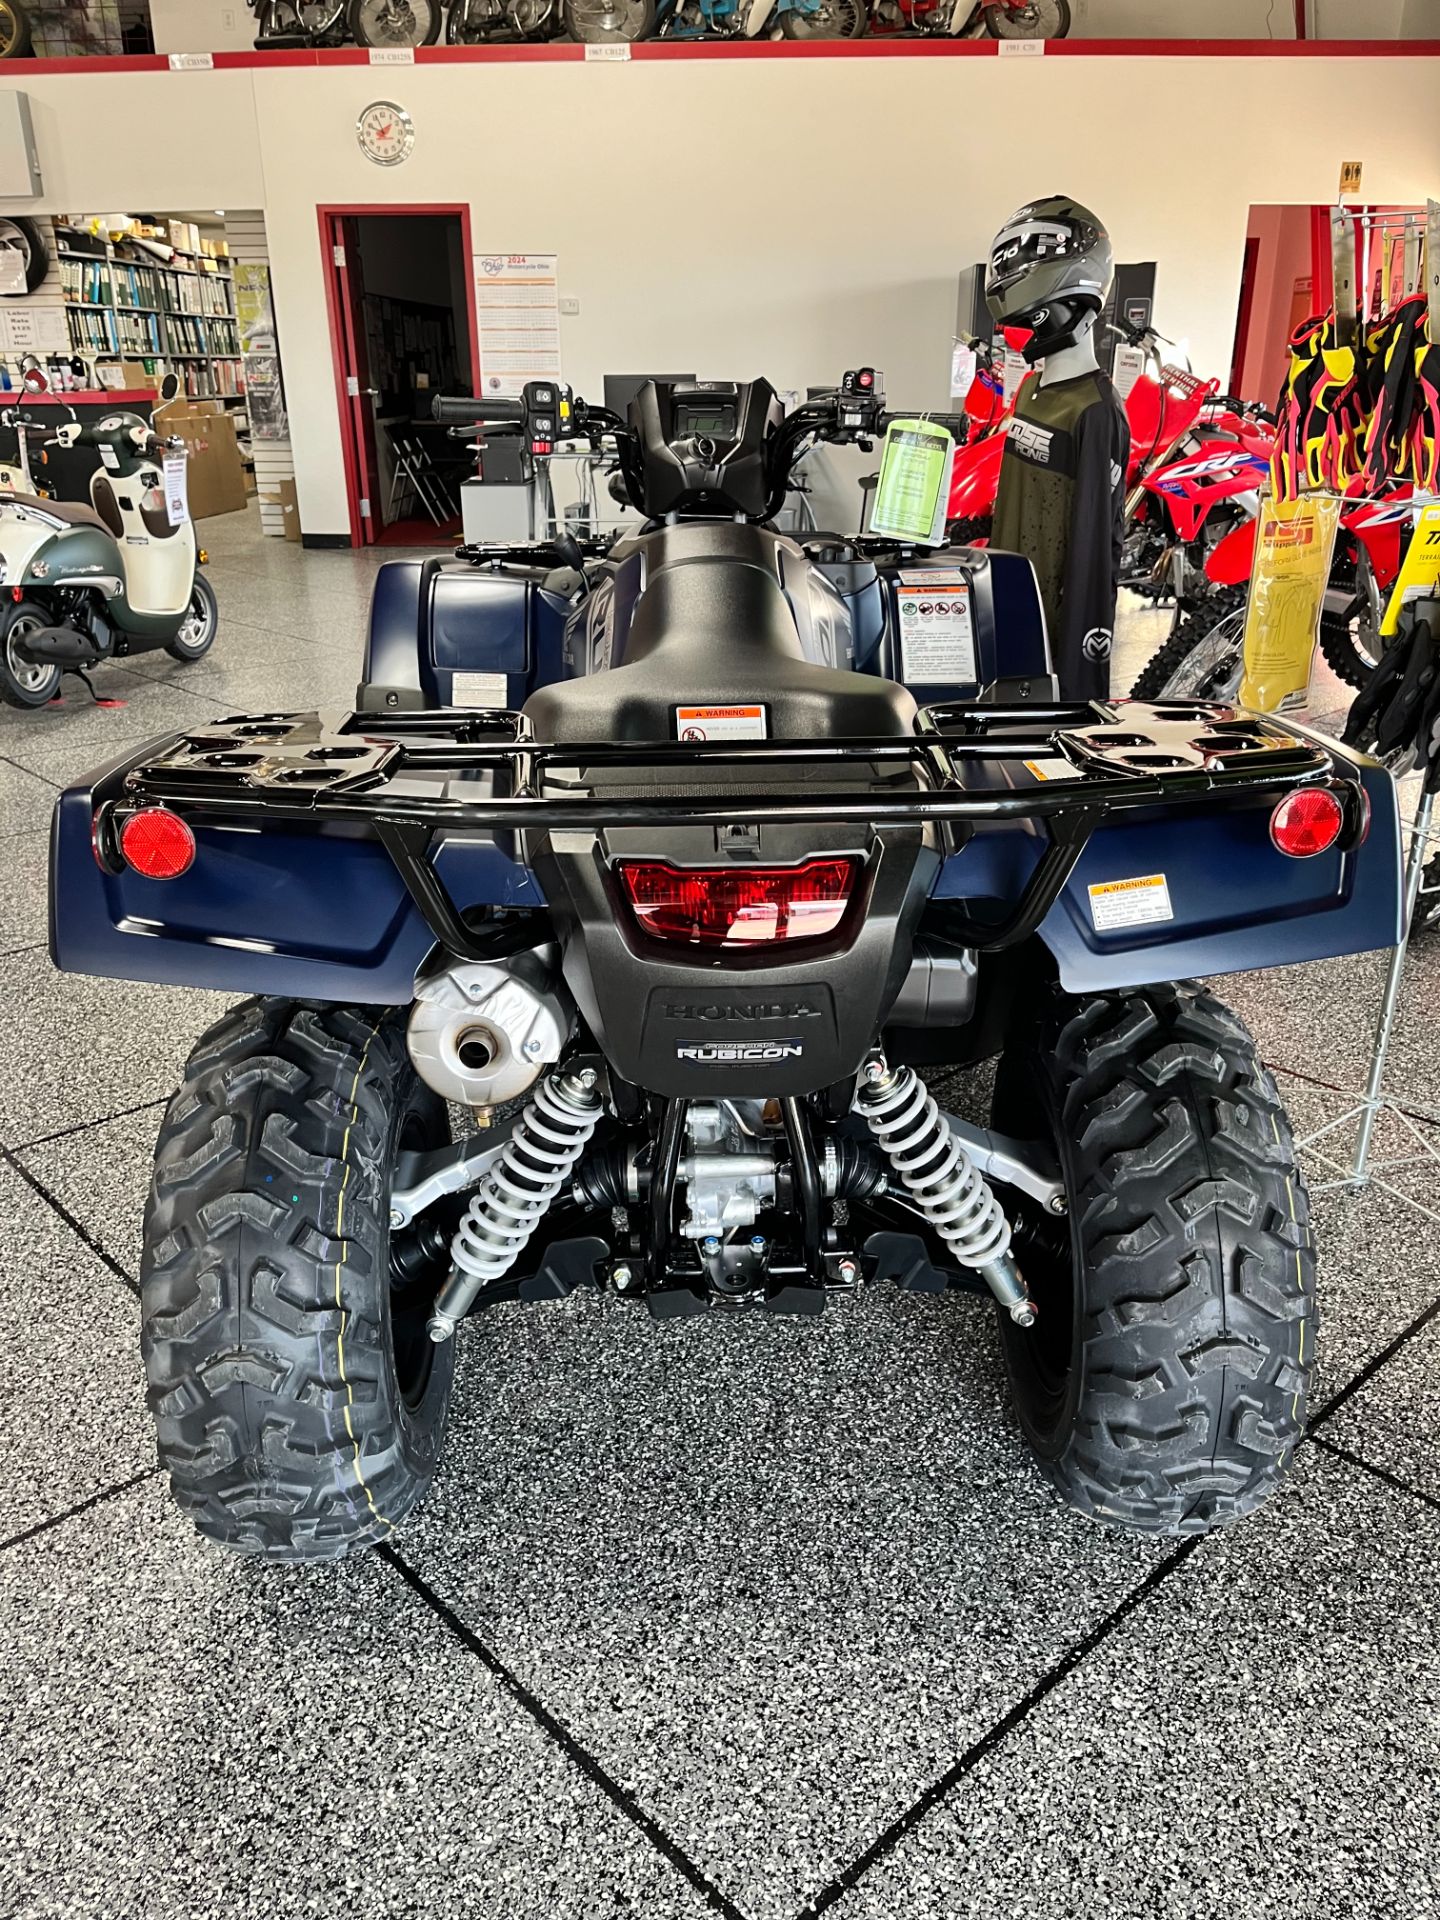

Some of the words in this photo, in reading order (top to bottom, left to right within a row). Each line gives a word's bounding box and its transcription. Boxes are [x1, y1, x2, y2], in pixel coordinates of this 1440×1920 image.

[507, 256, 527, 264] 2024
[1157, 451, 1253, 481] CRF
[705, 709, 745, 717] WARNING
[1112, 879, 1152, 893] WARNING
[663, 1003, 822, 1021] HONDA
[677, 1045, 803, 1060] RUBICON
